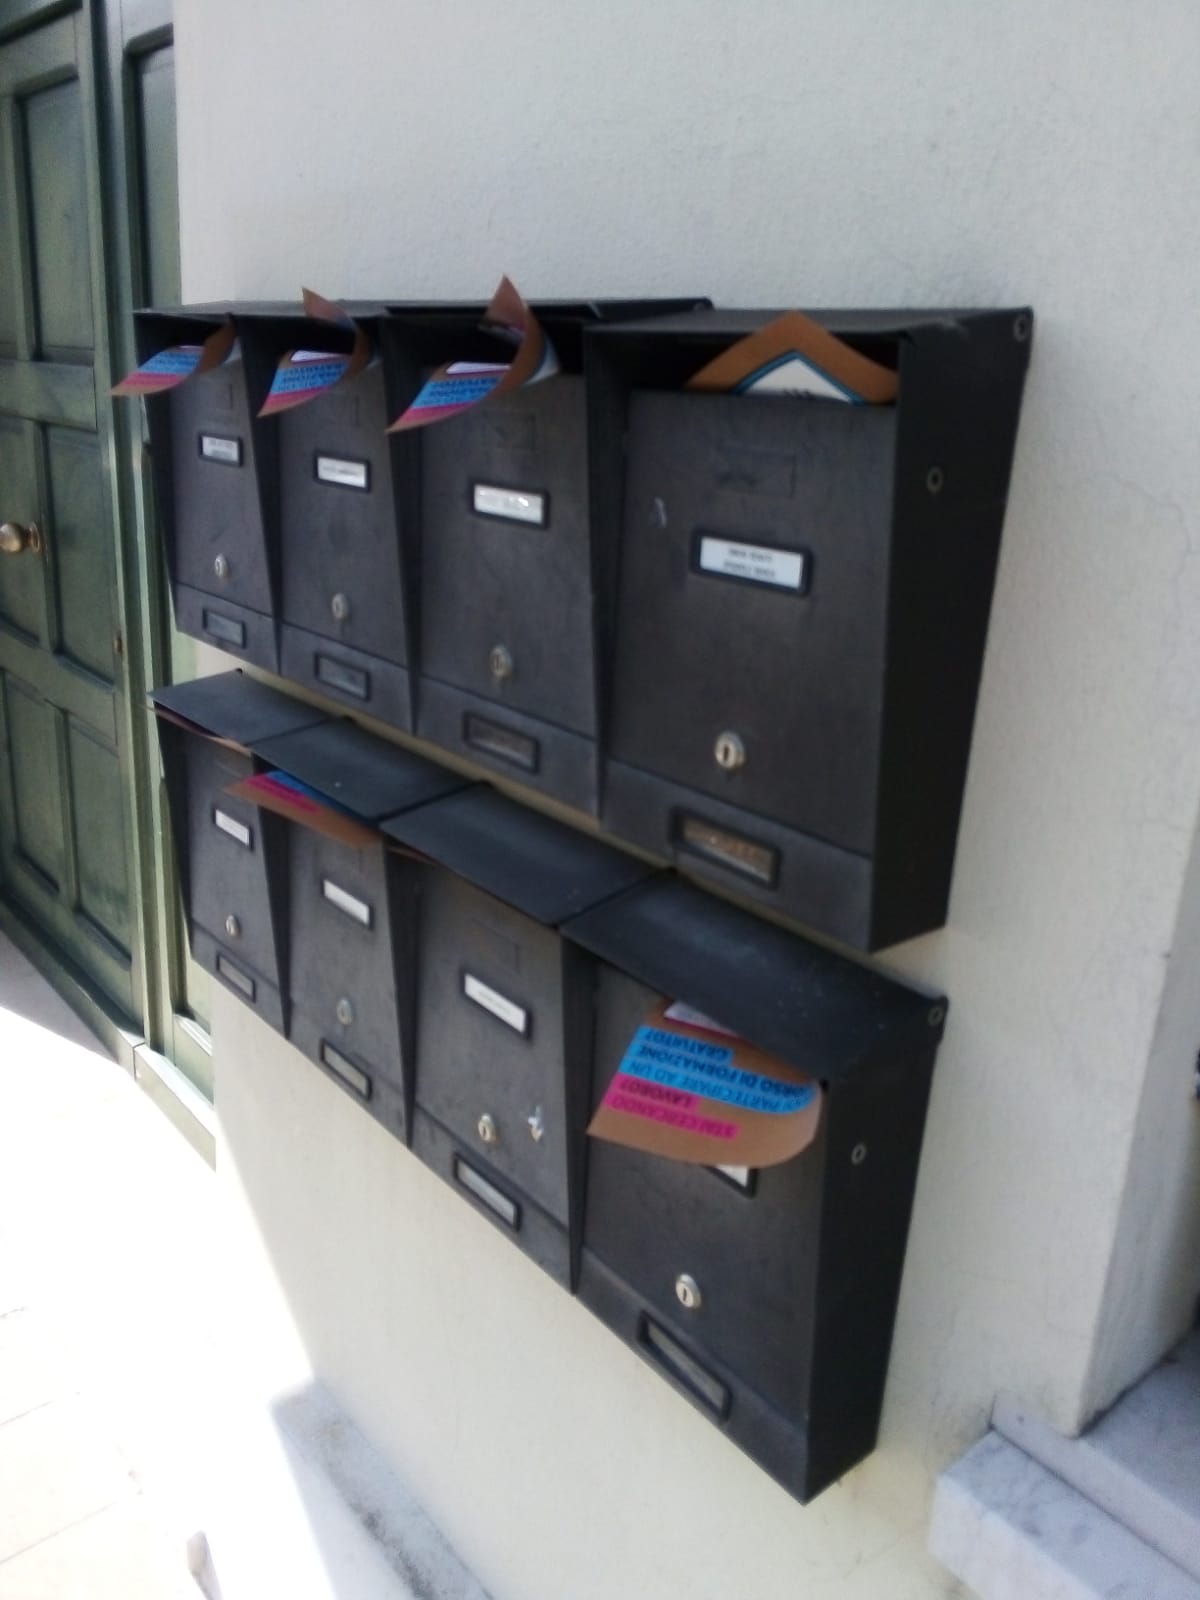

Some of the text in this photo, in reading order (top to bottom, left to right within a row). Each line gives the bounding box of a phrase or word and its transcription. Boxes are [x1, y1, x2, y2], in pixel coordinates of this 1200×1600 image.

[639, 1044, 737, 1081] FORMAZIONE
[643, 1028, 731, 1061] GRATUITO?
[610, 1093, 698, 1130] CERCANDO
